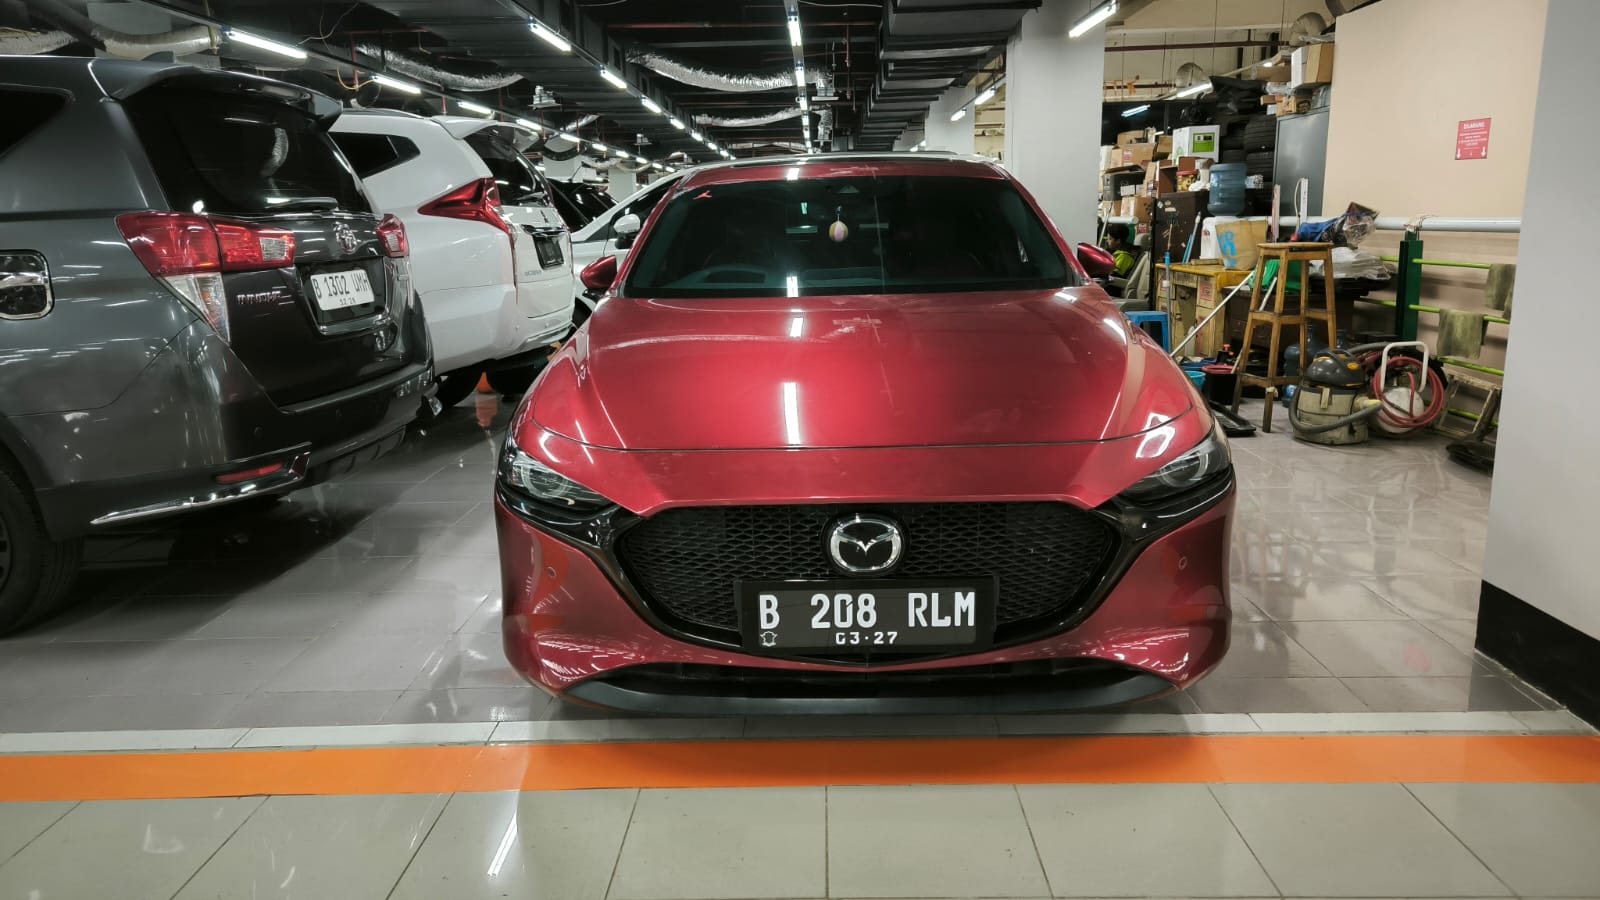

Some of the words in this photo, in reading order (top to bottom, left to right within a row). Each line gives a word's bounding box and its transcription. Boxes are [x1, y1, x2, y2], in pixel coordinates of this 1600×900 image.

[312, 278, 322, 299] B
[324, 275, 350, 297] 1302
[759, 594, 780, 629] B
[810, 593, 877, 629] 208
[908, 591, 975, 628] RLM
